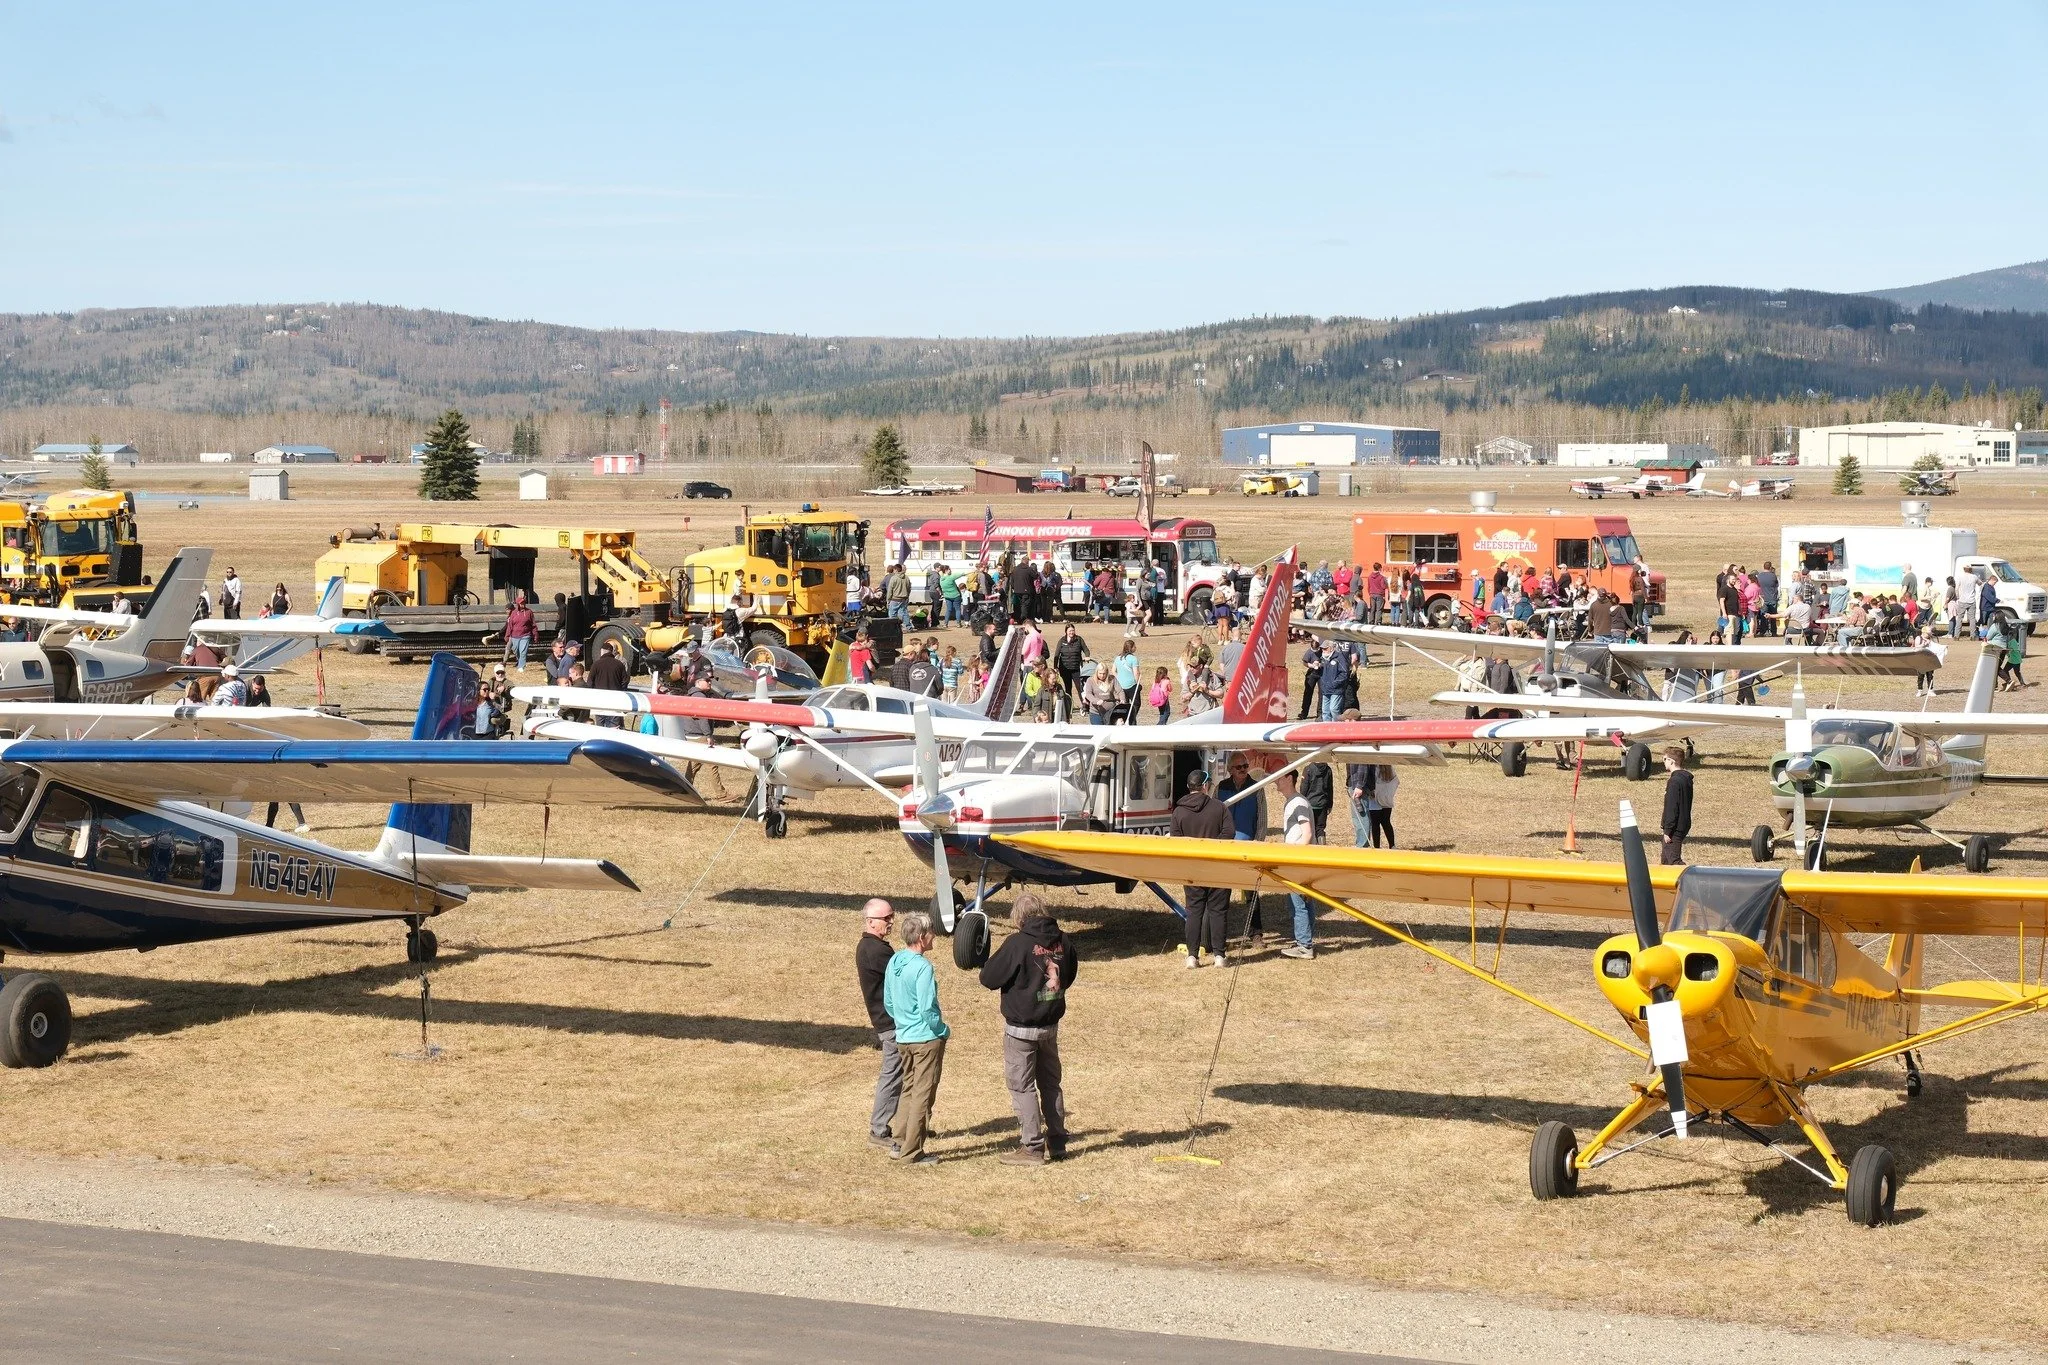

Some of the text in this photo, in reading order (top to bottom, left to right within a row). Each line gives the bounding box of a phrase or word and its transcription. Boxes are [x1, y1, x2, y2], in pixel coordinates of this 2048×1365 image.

[1038, 526, 1092, 537] HOTDOGS
[1474, 540, 1536, 550] CHEESESTEAK
[1237, 579, 1290, 716] CIVIL AIR PATROL
[249, 848, 338, 902] N6464V
